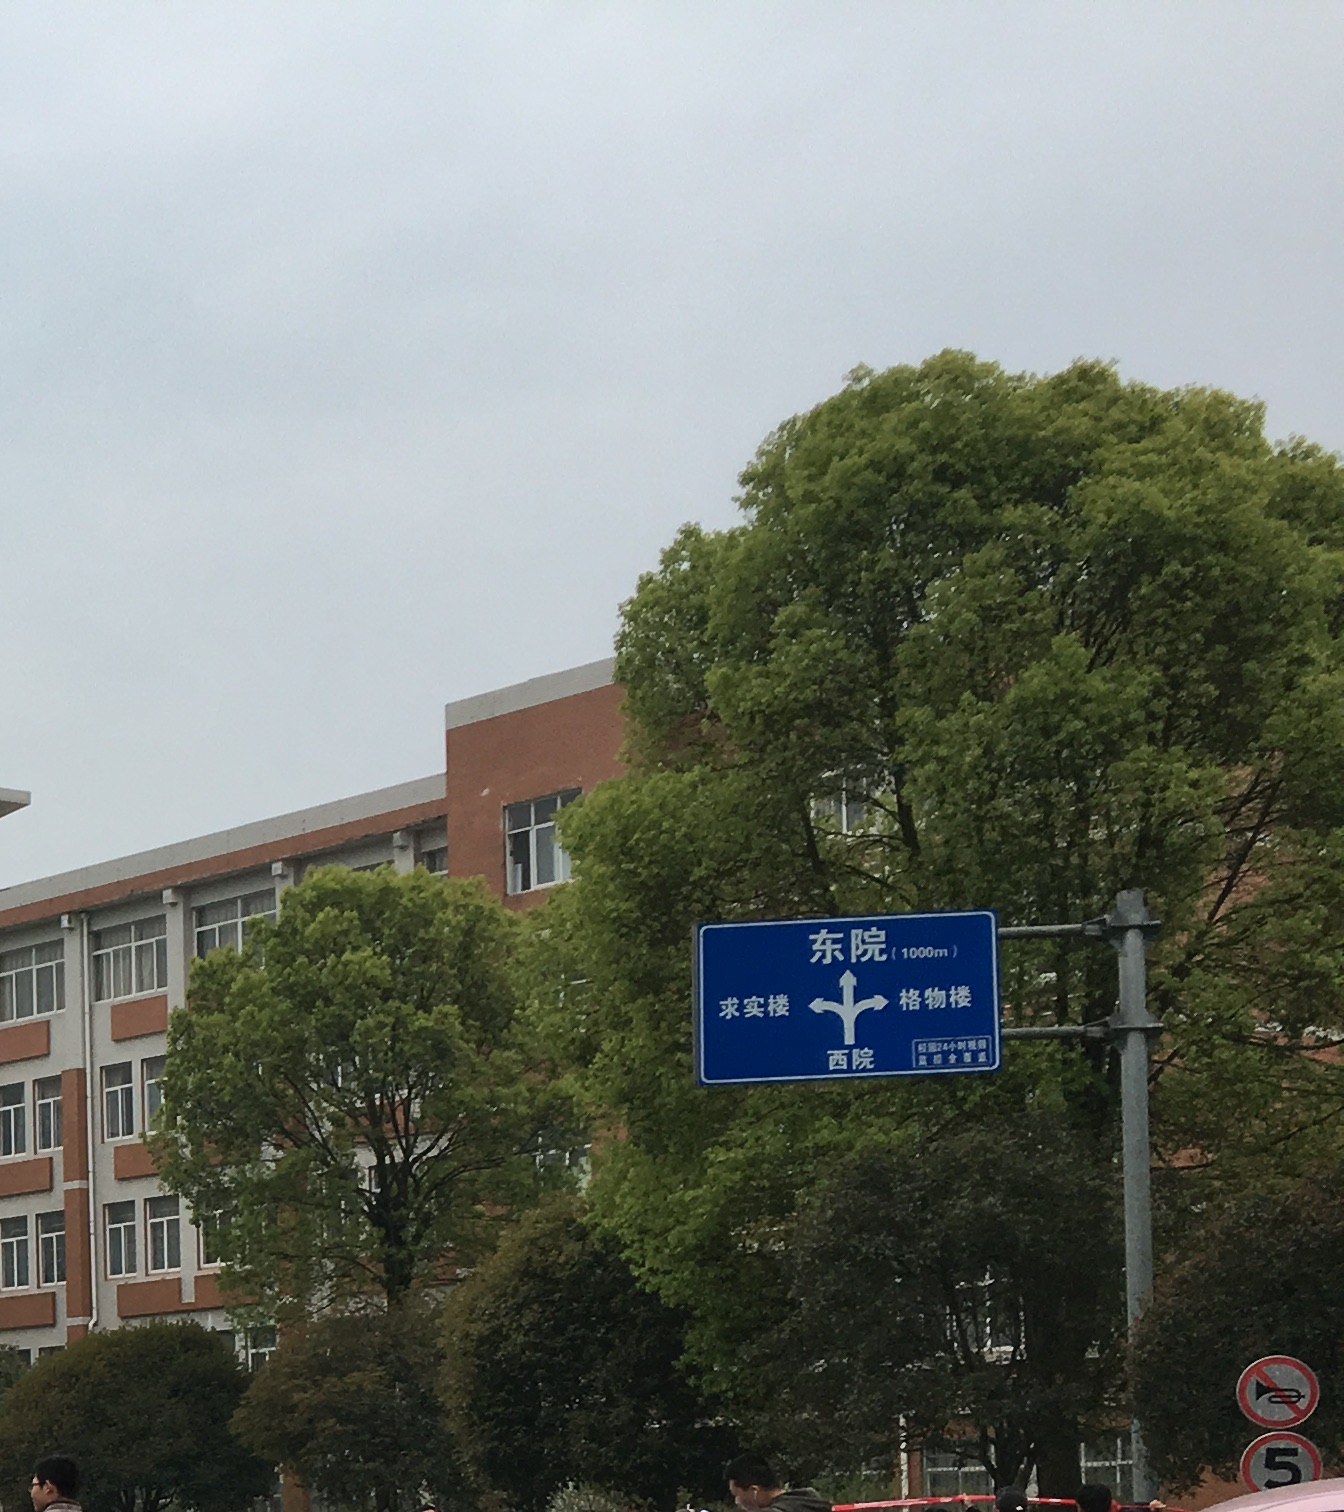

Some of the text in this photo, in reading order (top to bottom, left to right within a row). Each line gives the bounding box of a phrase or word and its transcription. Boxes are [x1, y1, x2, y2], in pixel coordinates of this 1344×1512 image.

[809, 927, 888, 965] 东院
[719, 994, 790, 1020] 求实楼
[899, 985, 972, 1011] 格物楼
[827, 1048, 874, 1071] 西院
[1264, 1447, 1302, 1488] 5
